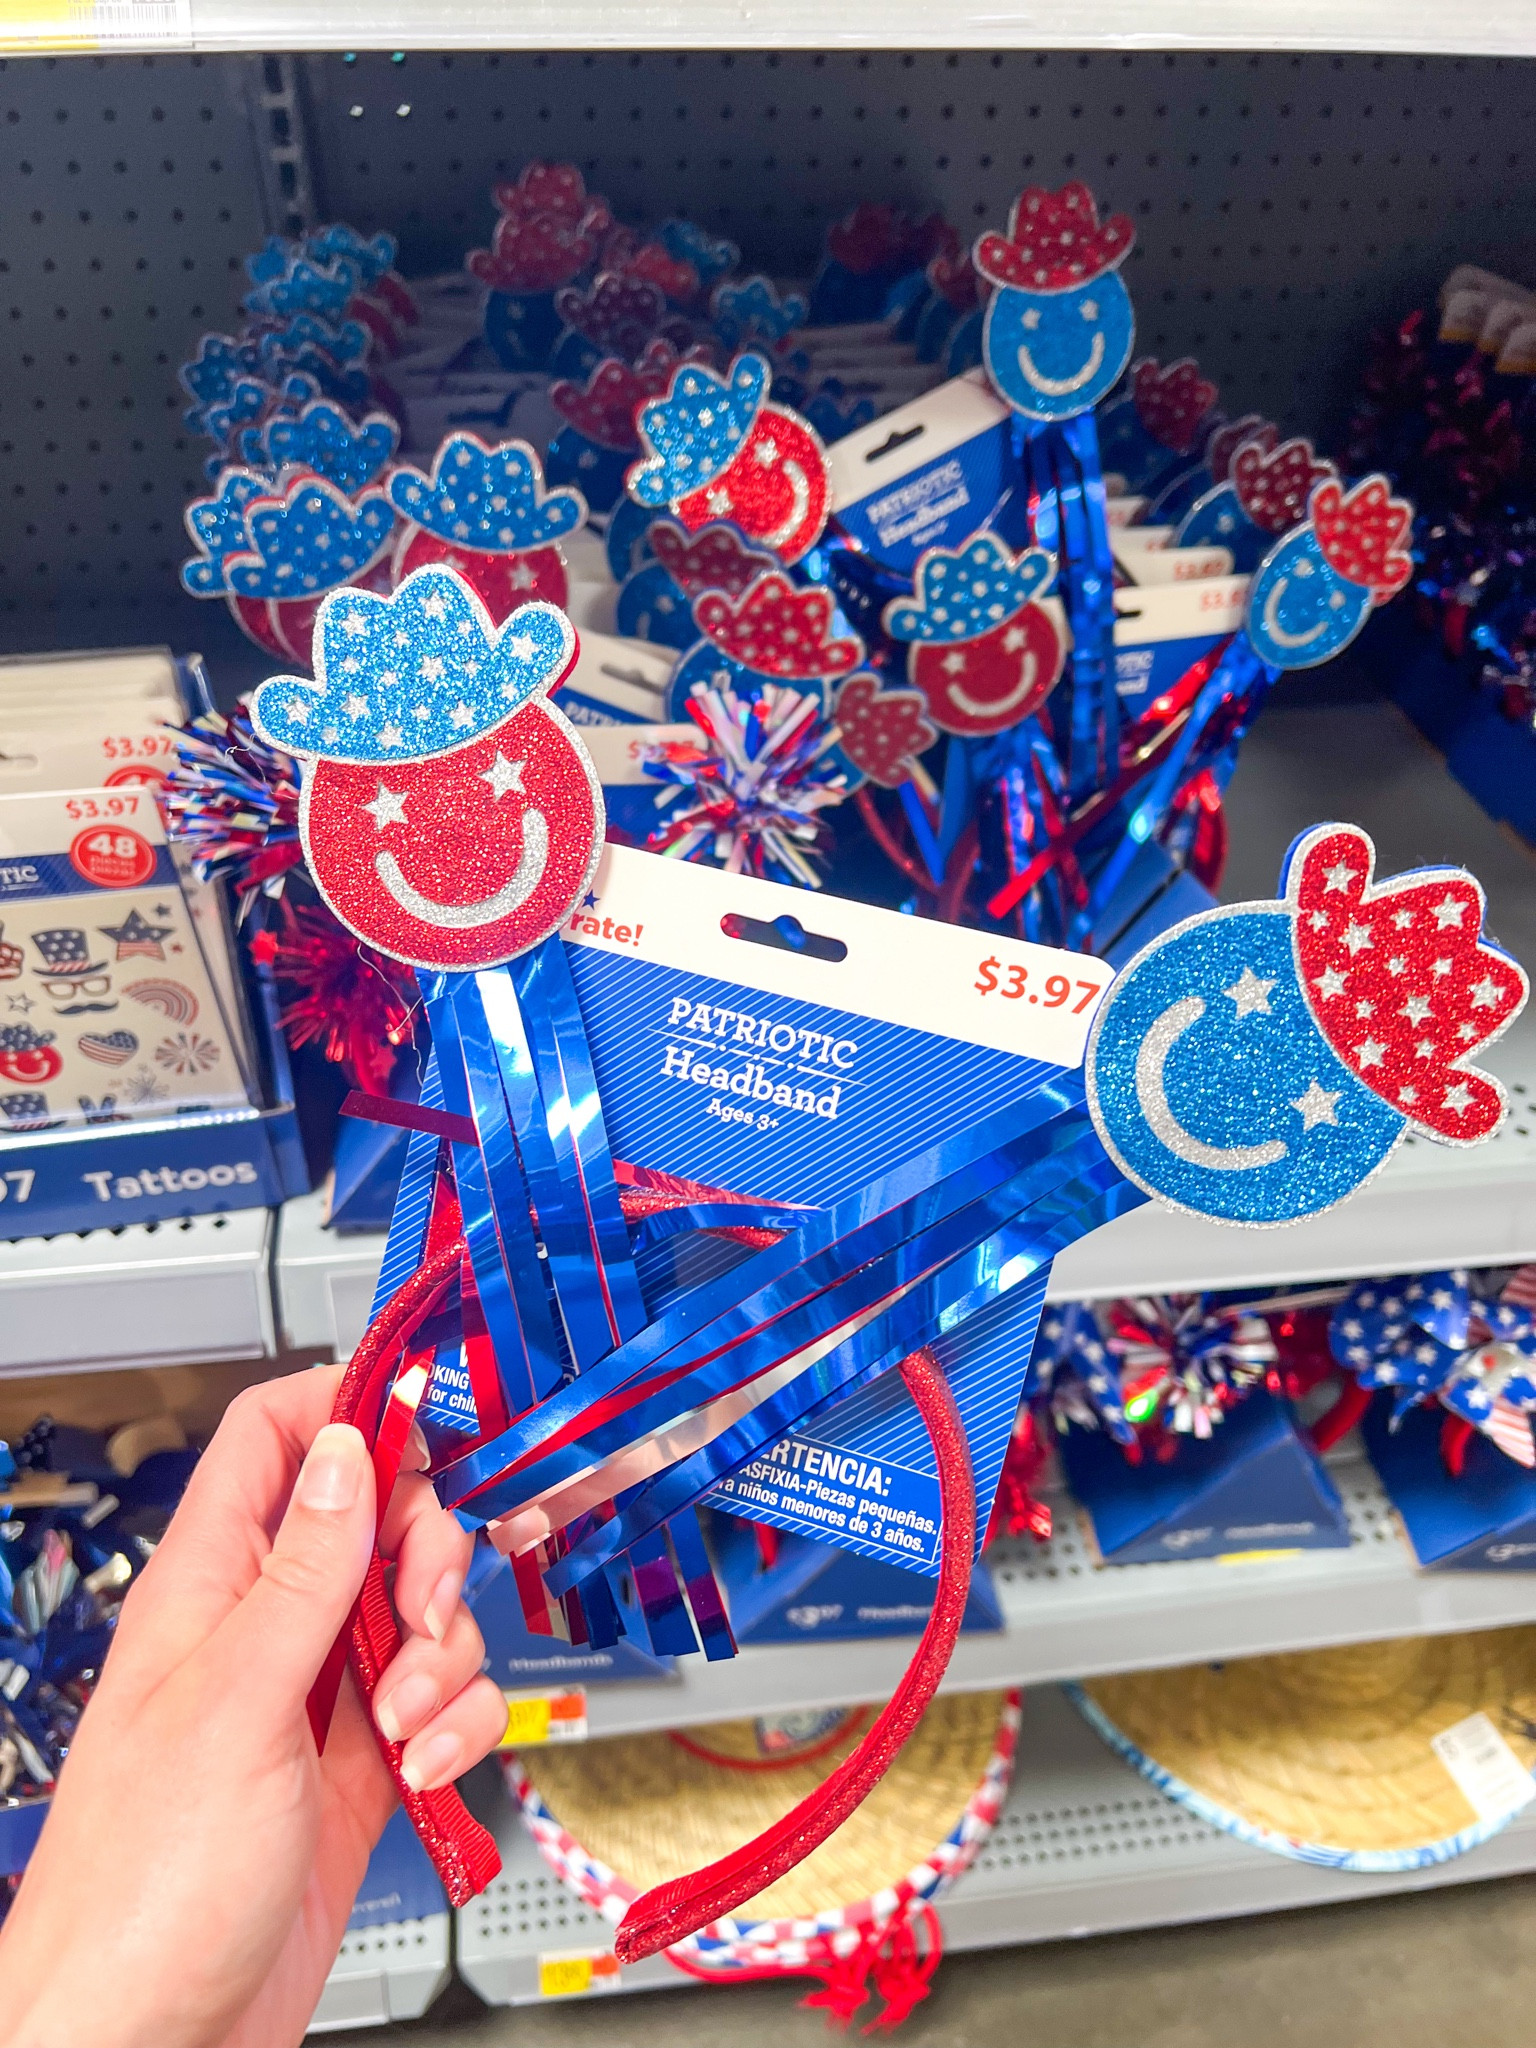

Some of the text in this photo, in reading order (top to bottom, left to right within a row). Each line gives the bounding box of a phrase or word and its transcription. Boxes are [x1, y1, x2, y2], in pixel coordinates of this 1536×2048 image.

[102, 735, 172, 759] $3.97
[65, 796, 140, 820] $3.97
[88, 834, 138, 858] 48
[570, 913, 643, 947] rate!
[974, 955, 1101, 1014] $3.97
[667, 997, 858, 1070] PATRIOTIC
[660, 1045, 842, 1120] Headband
[706, 1098, 780, 1131] Ages 3+
[81, 1161, 258, 1202] Tattoos
[427, 1384, 448, 1403] for
[761, 1439, 893, 1497] RTENCIA:
[738, 1481, 778, 1506] niños
[781, 1495, 846, 1527] menores
[849, 1514, 869, 1534] de
[870, 1524, 882, 1538] 3
[884, 1528, 926, 1553] años.
[858, 1498, 938, 1536] pequeñas.
